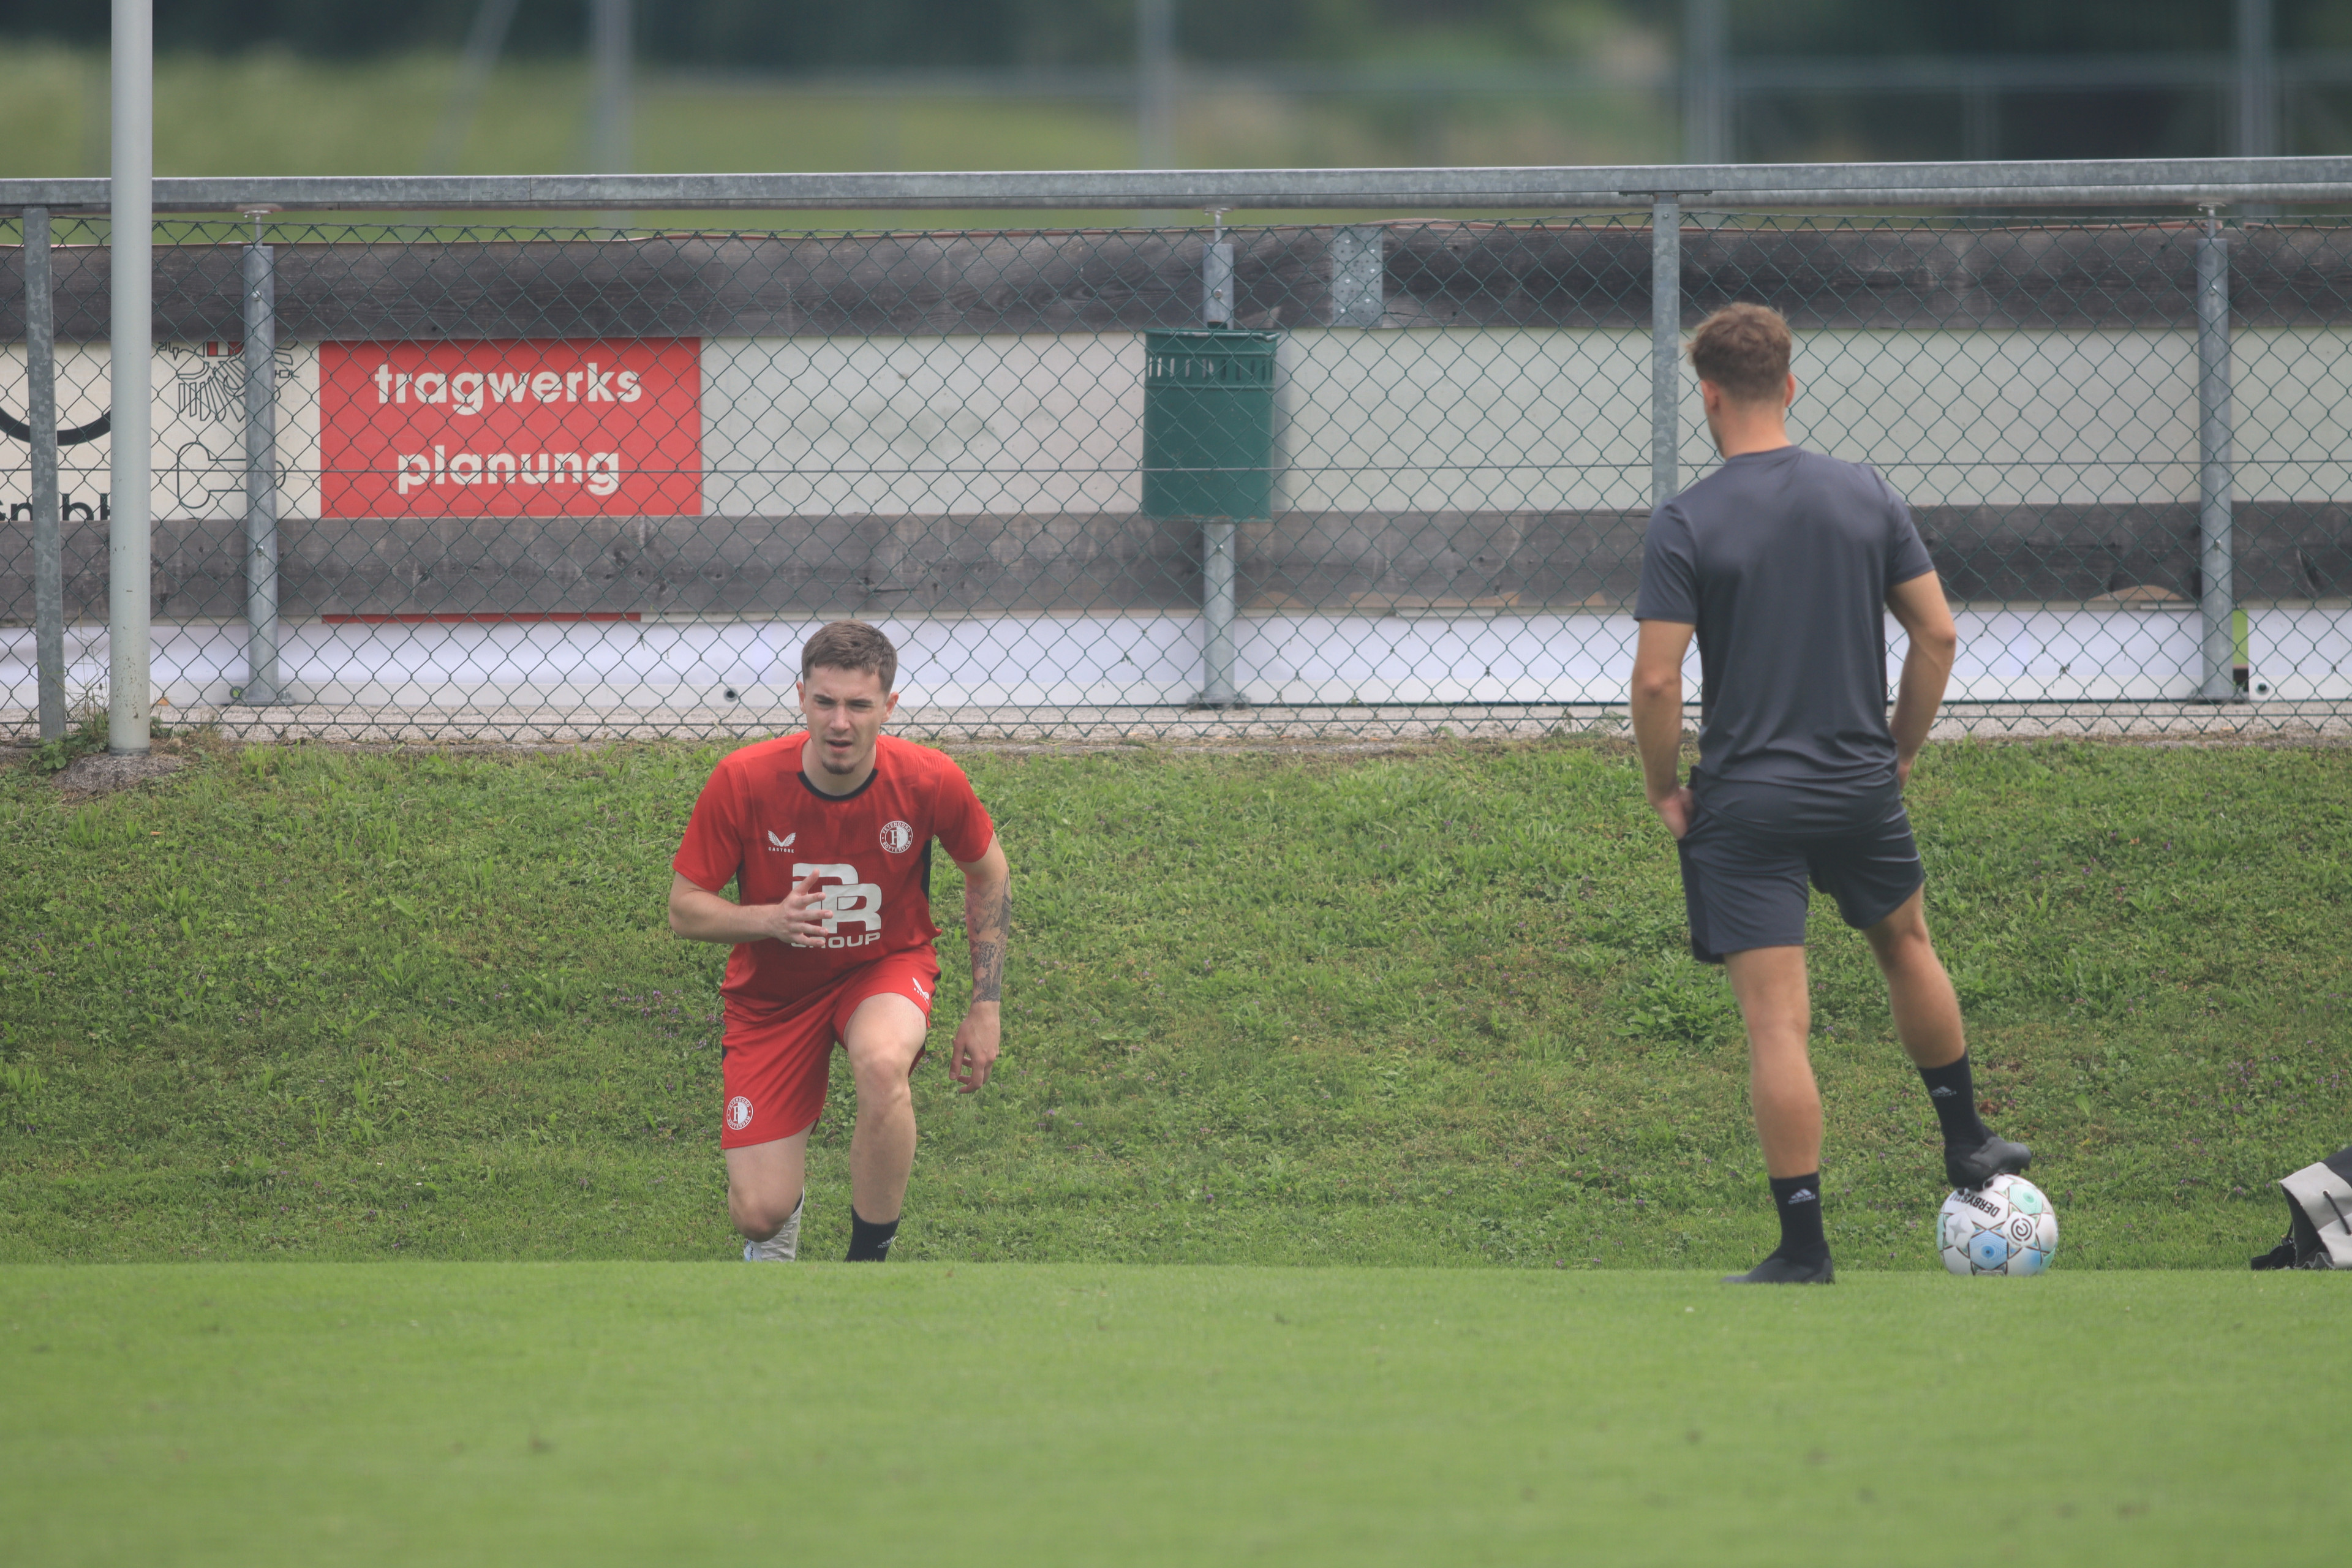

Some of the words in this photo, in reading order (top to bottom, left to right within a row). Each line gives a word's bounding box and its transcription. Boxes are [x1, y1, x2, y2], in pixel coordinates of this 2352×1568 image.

[375, 363, 642, 415] tragwerks
[398, 445, 619, 496] planung
[882, 822, 911, 834] FEYENOORD
[882, 840, 911, 852] ROTTERDAM
[791, 932, 881, 949] ROUP
[728, 1098, 750, 1110] FEYENOORD
[728, 1115, 751, 1129] ROTTERDAM
